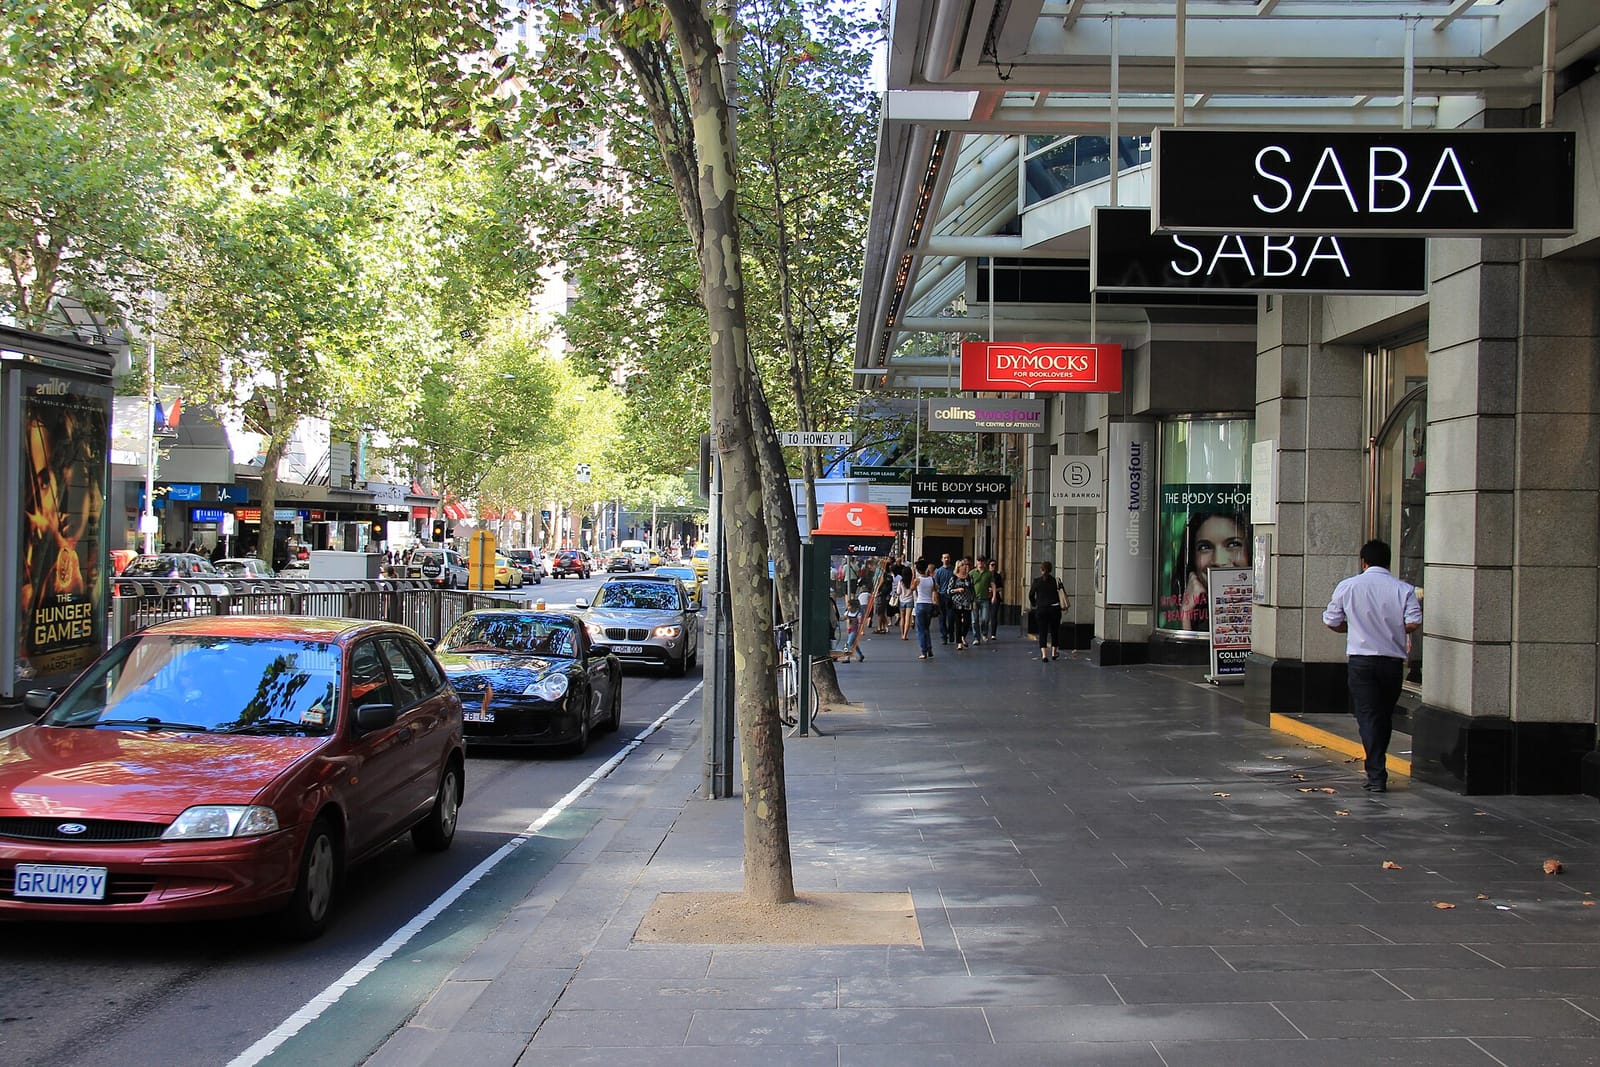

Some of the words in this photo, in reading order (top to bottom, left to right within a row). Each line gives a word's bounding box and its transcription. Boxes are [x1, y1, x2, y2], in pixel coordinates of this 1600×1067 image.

[1253, 146, 1479, 213] SABA
[1171, 235, 1350, 278] SABA
[997, 355, 1088, 371] DYMOCKS
[789, 434, 799, 444] TO
[804, 434, 834, 444] HOWEY
[840, 434, 852, 445] PL
[917, 482, 938, 491] THE
[942, 482, 973, 492] BODY
[1165, 493, 1179, 504] THE
[1182, 492, 1214, 504] BODY
[957, 507, 983, 515] GLASS
[848, 545, 876, 553] Telstra
[56, 593, 72, 603] THE
[36, 603, 91, 624] HUNGER
[35, 619, 92, 645] GAMES
[18, 872, 104, 895] GRUM9Y
